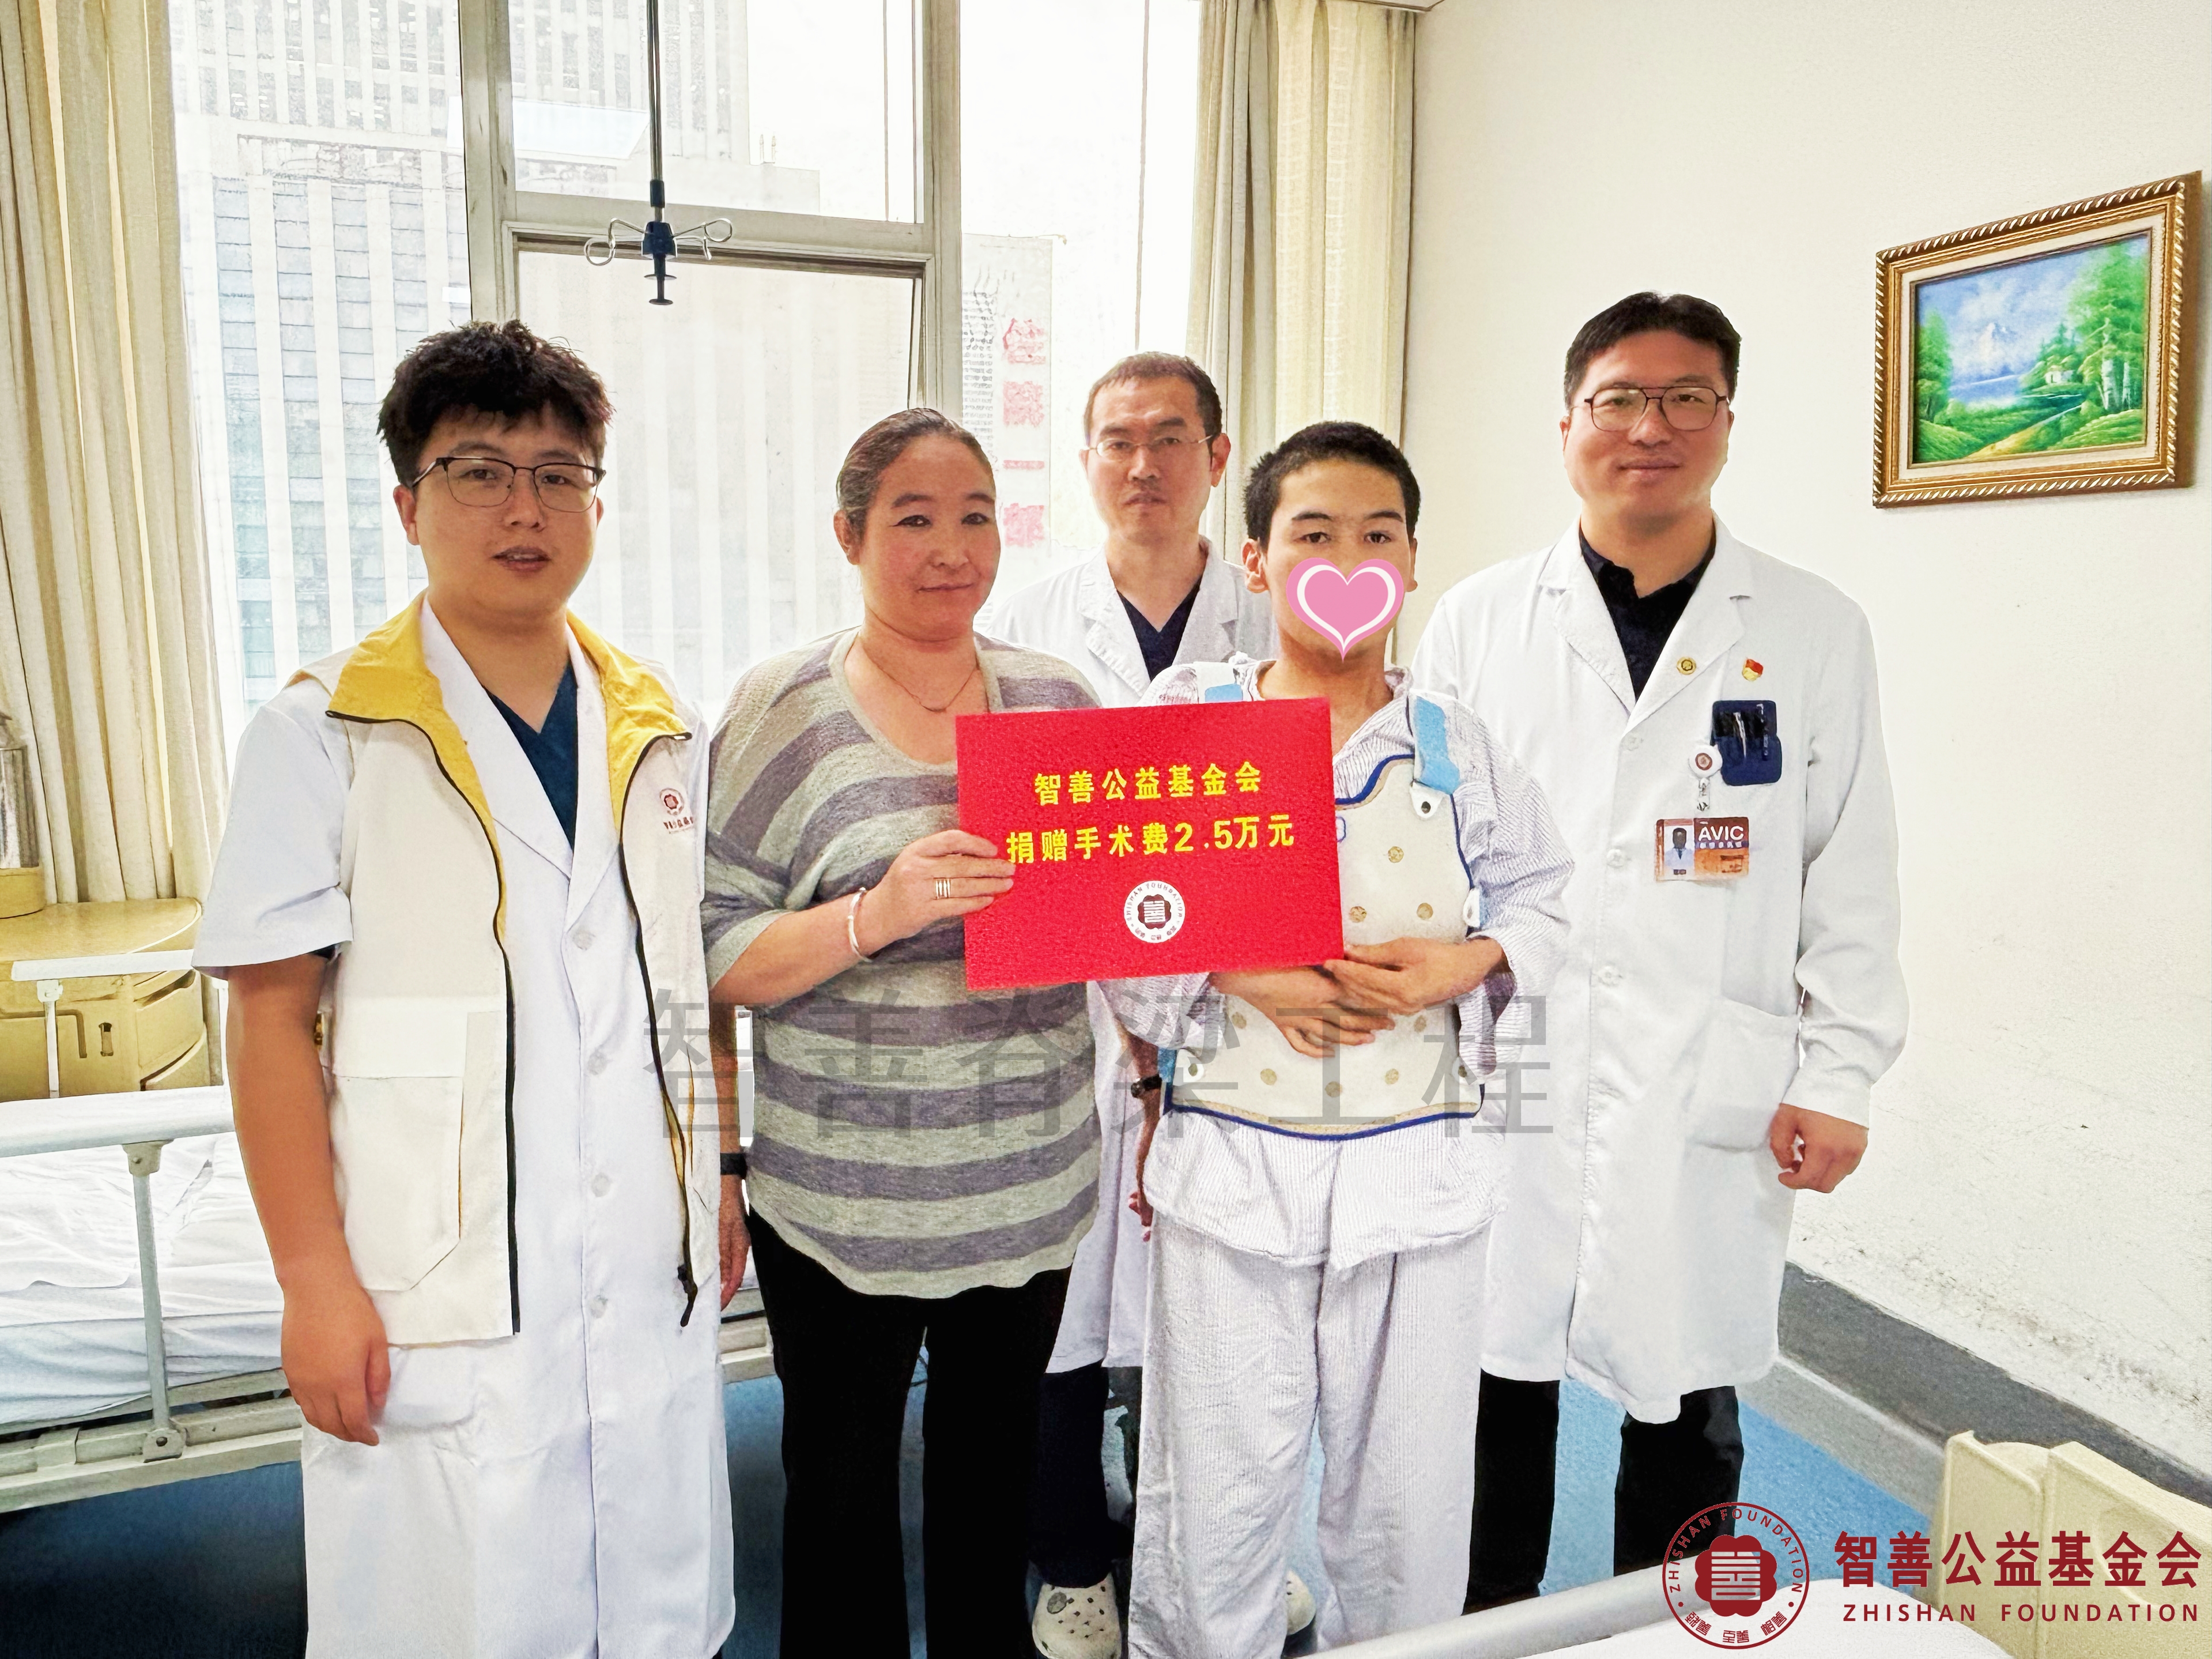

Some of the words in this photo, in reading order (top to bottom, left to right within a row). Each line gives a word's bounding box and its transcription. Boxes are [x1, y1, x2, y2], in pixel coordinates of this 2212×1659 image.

[1034, 761, 1262, 806] 智善公益基金会
[1006, 814, 1294, 864] 捐赠手术费2.5万元
[1698, 825, 1744, 842] AVIC
